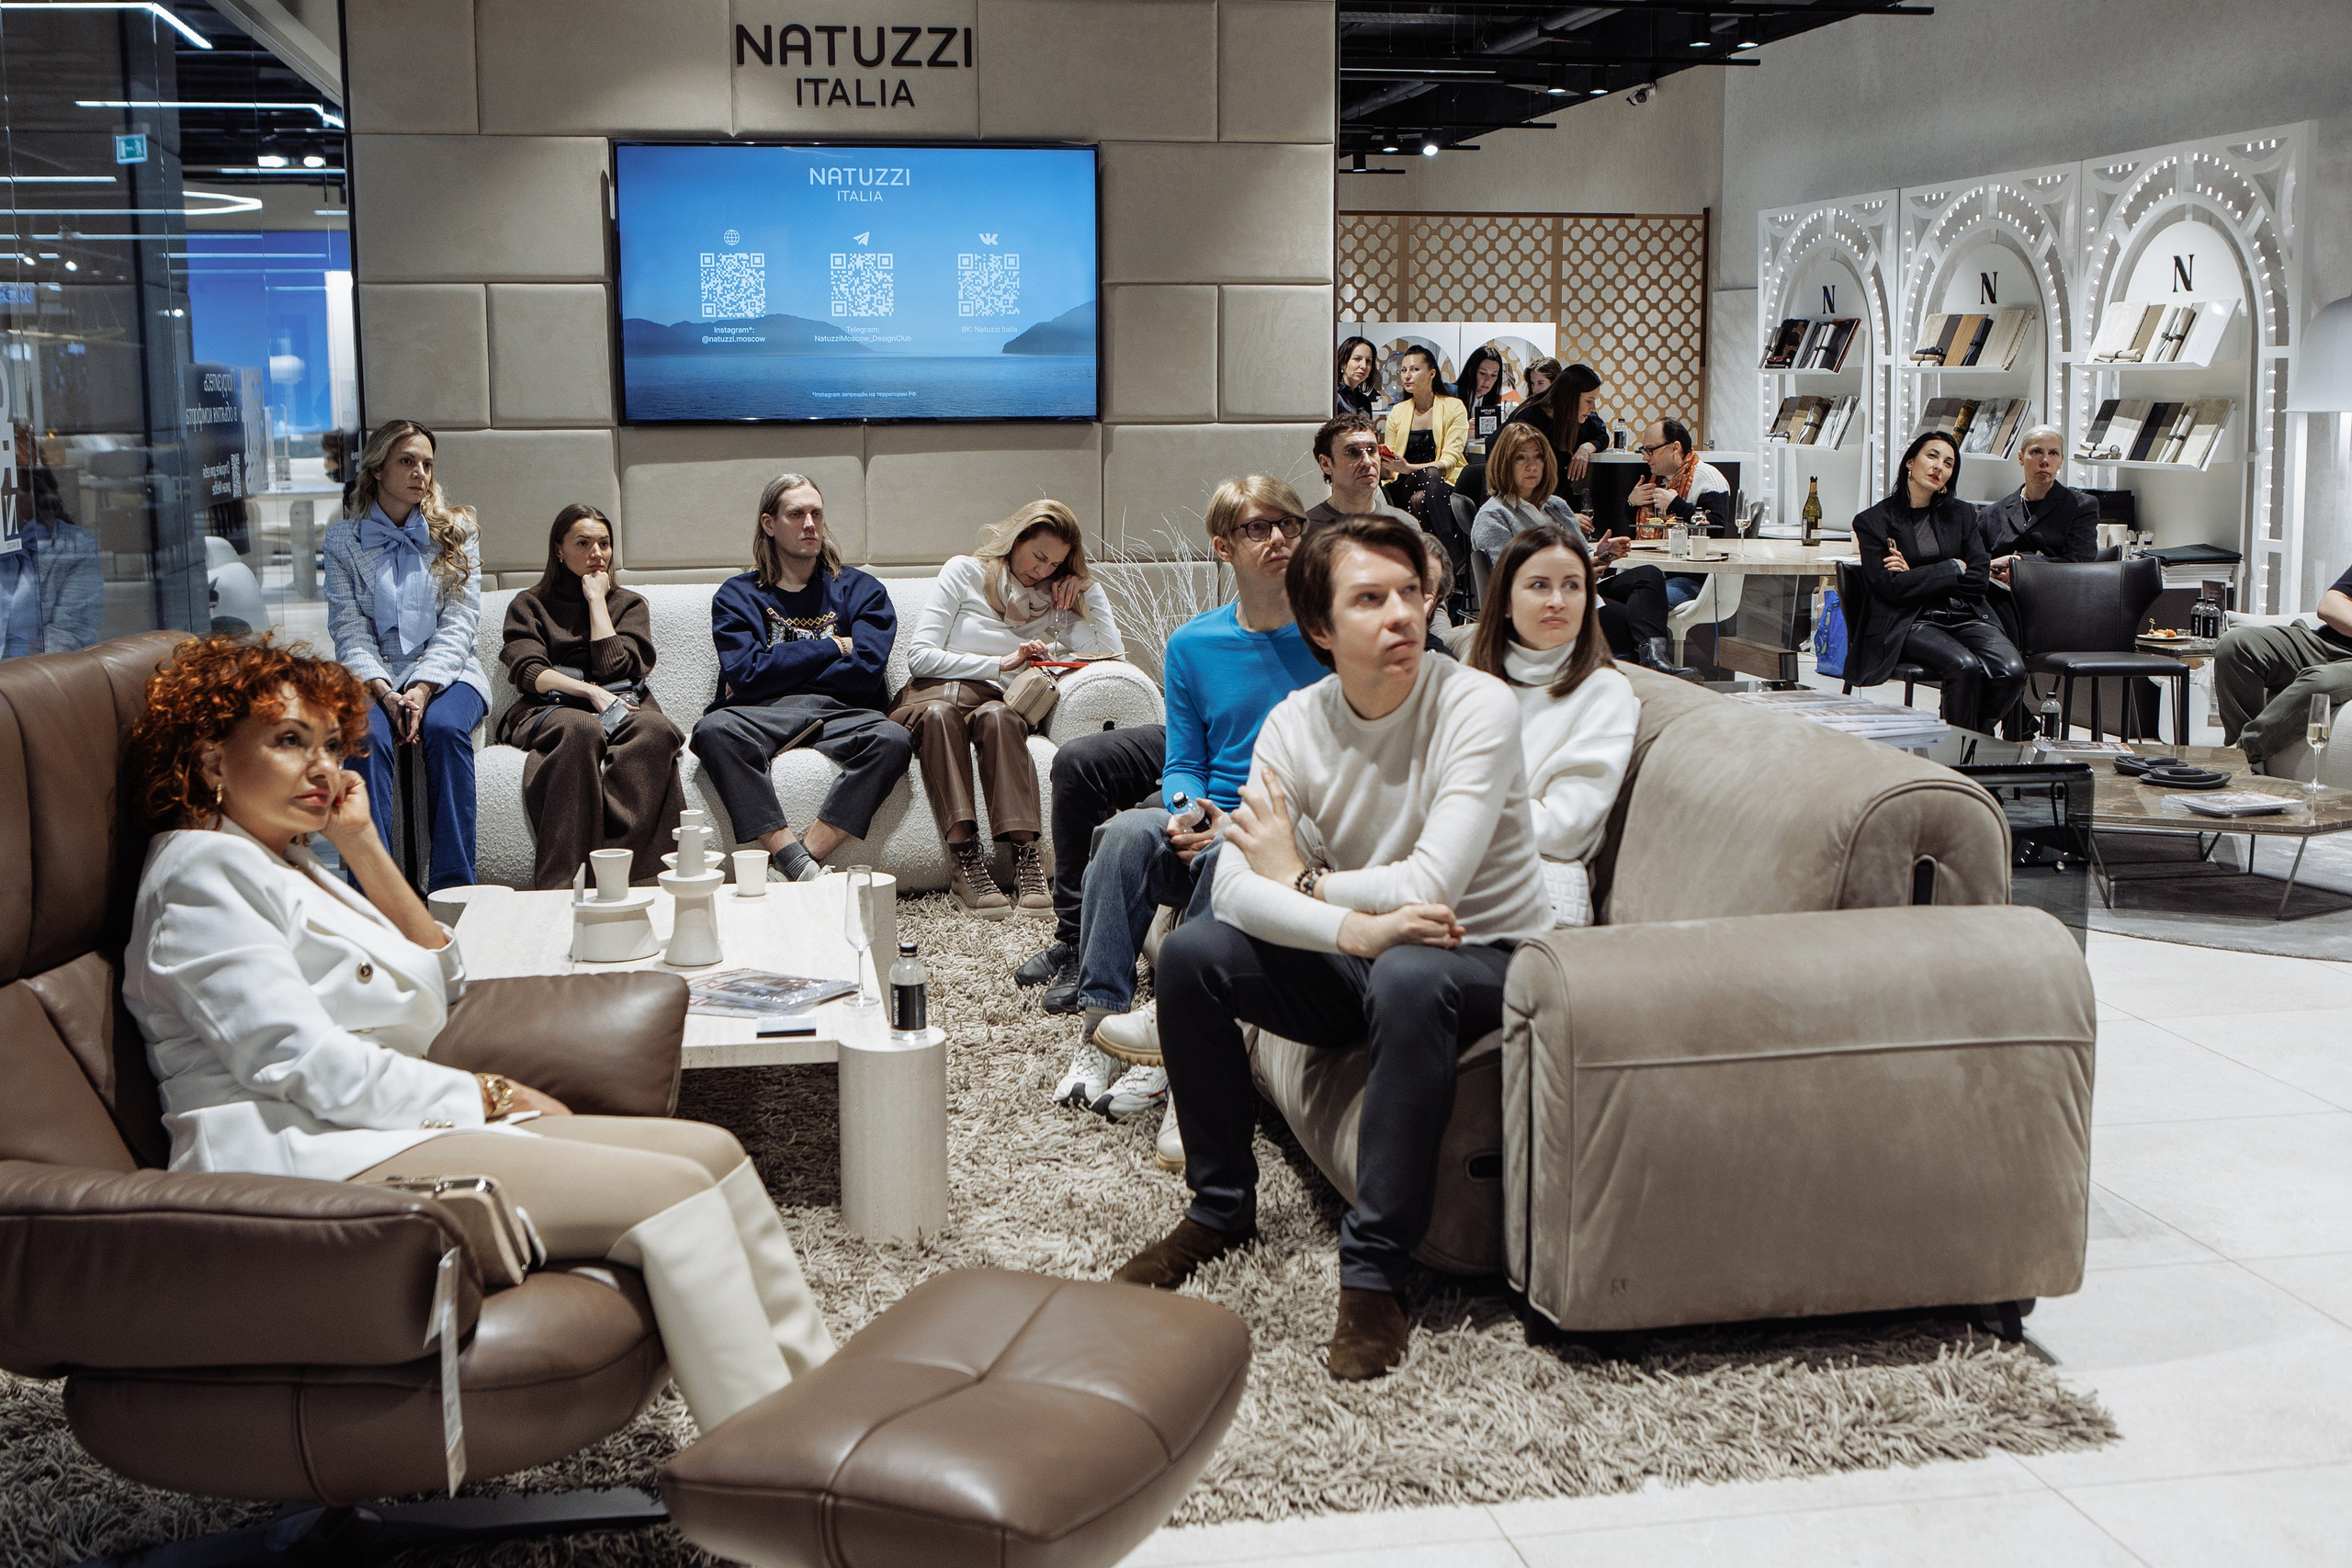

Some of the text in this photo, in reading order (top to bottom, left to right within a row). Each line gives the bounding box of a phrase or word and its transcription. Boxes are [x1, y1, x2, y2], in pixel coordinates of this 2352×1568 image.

[736, 24, 972, 67] NATUZZI
[796, 78, 915, 107] ITALIA
[809, 167, 910, 186] NATUZZI
[837, 190, 883, 202] ITALIA
[2172, 254, 2195, 292] N
[1822, 285, 1836, 314] N
[1980, 271, 1998, 304] N
[701, 335, 766, 344] @natuzzi.moscow
[814, 334, 912, 344] NatuzziMoscow_DesignClub
[846, 325, 880, 334] Telegram:
